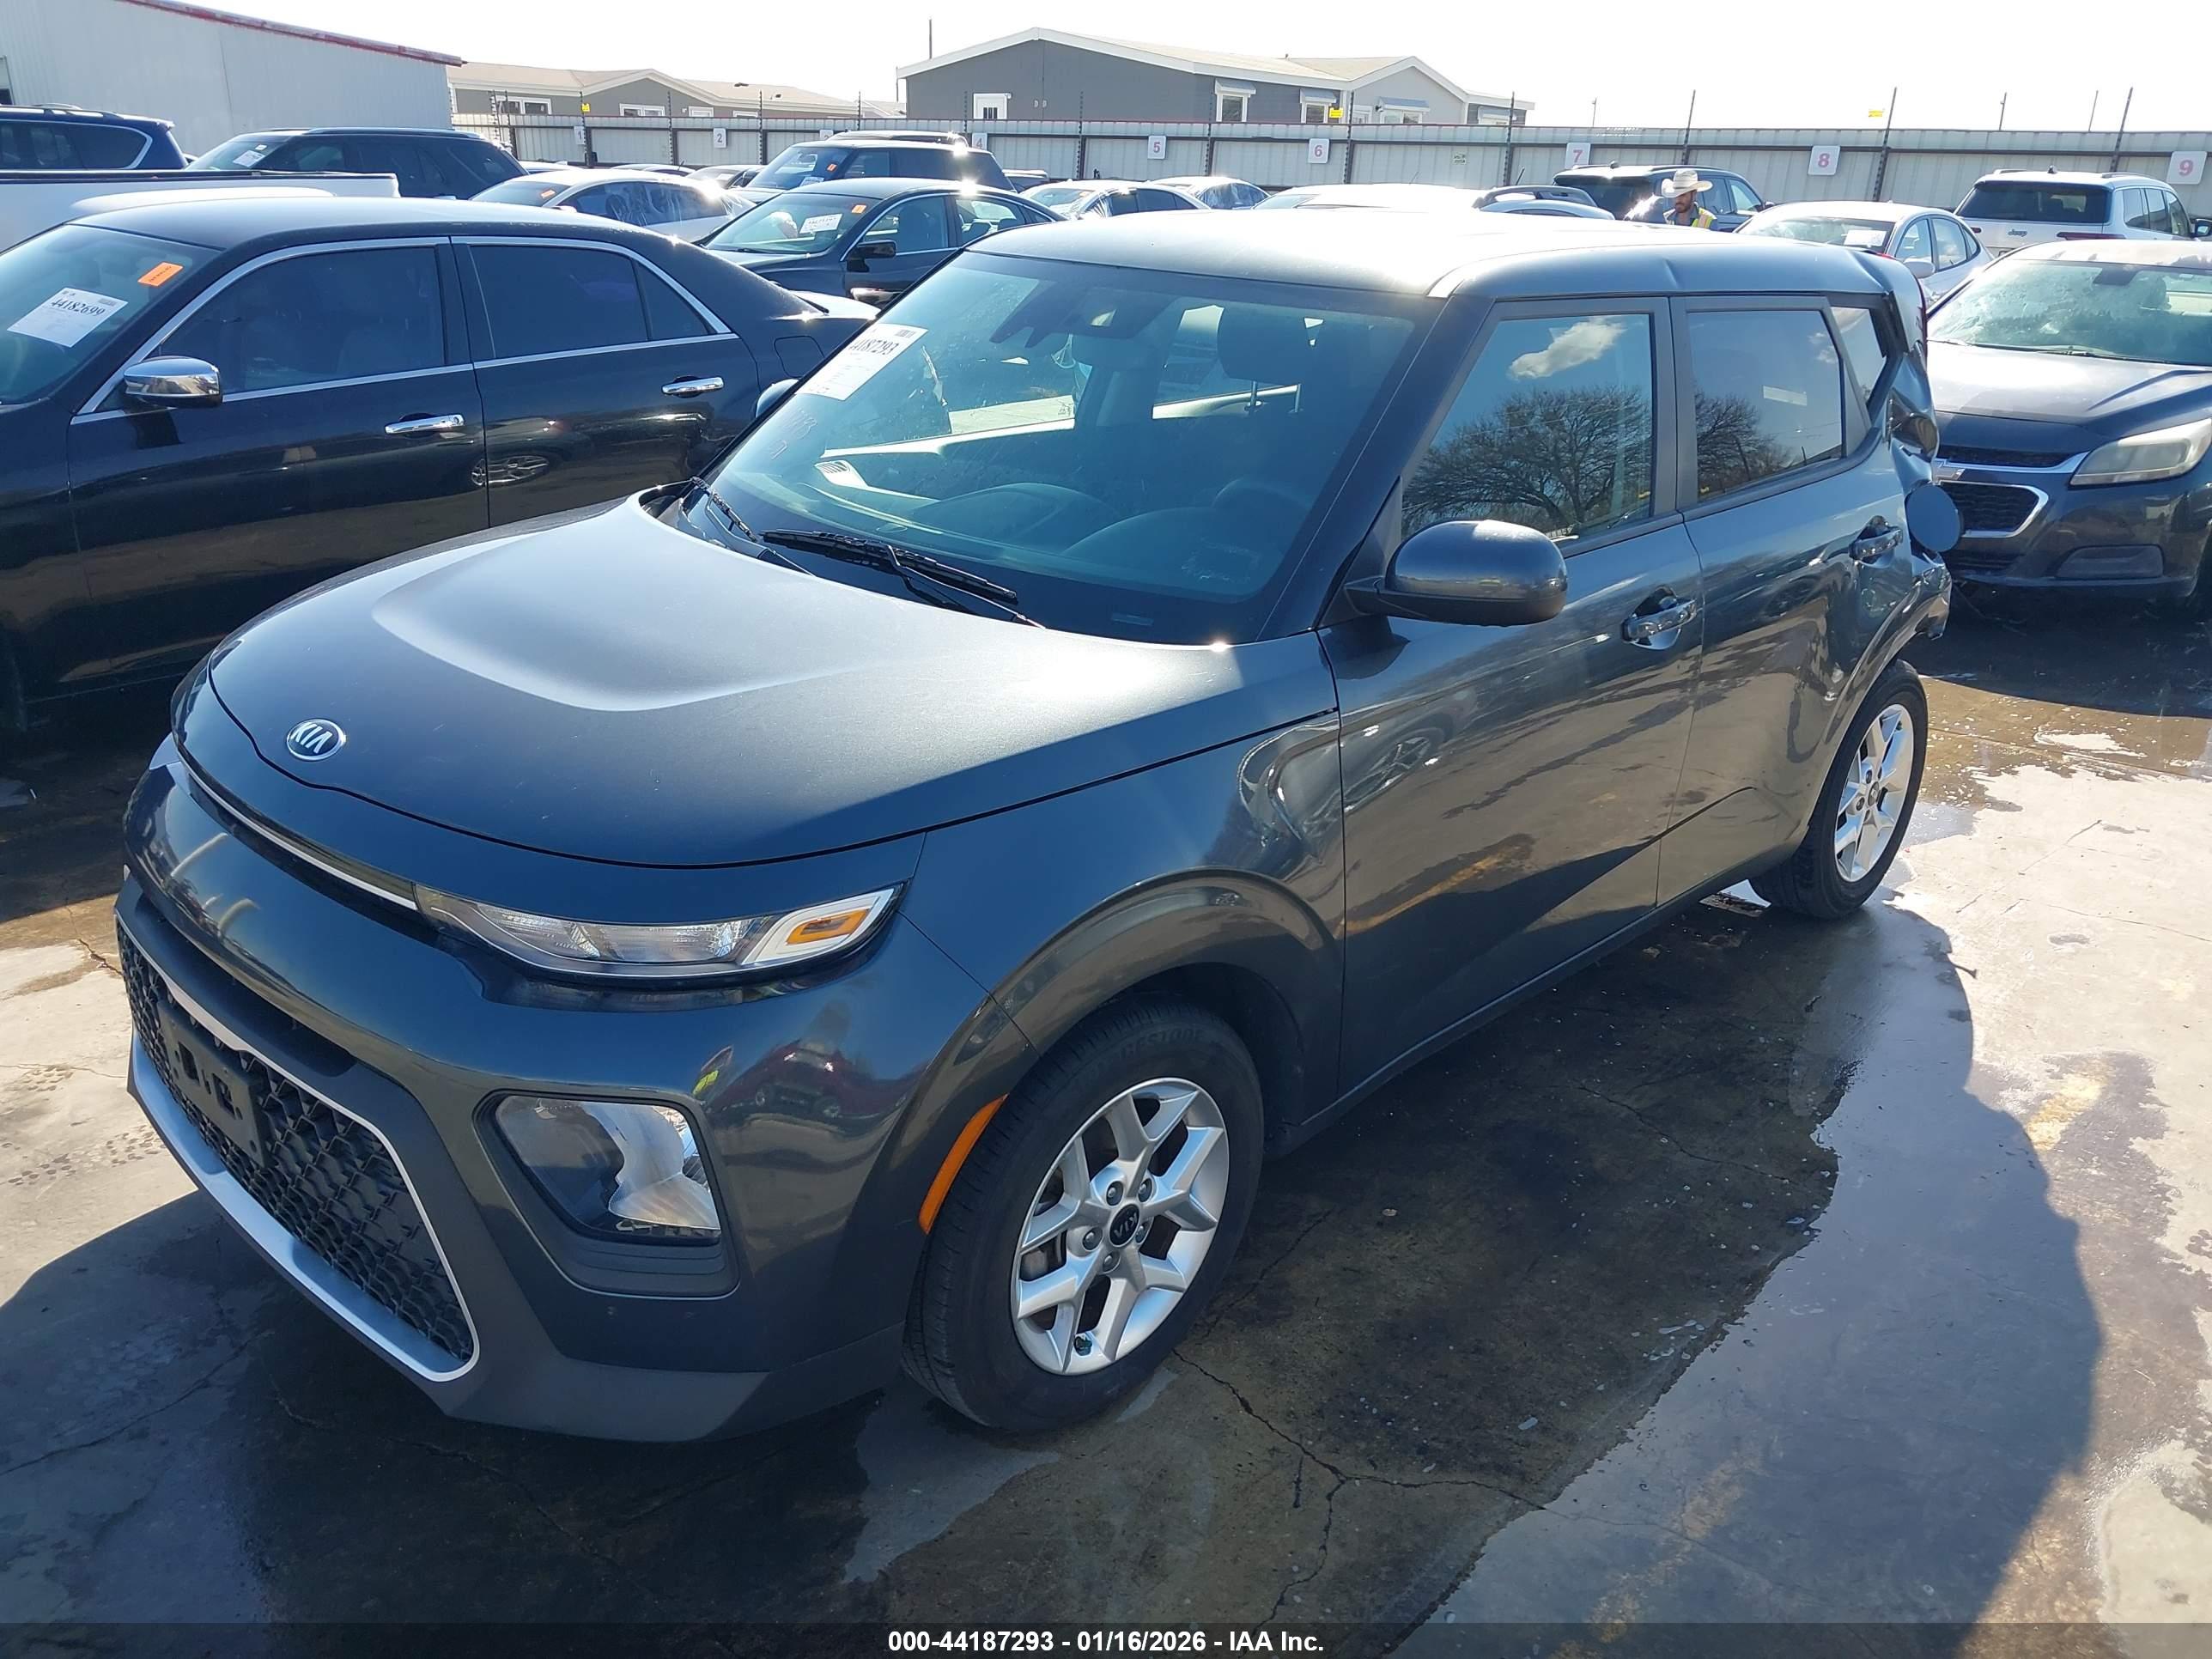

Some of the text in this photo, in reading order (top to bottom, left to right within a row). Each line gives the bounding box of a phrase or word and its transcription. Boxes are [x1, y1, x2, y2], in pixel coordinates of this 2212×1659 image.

[717, 133, 723, 143] 2
[975, 137, 983, 149] 4
[1153, 141, 1161, 154] 5
[1314, 144, 1323, 157] 6
[1573, 149, 1583, 162] 7
[1817, 153, 1831, 167] 8
[2179, 159, 2193, 176] 9
[51, 298, 106, 317] 44182699
